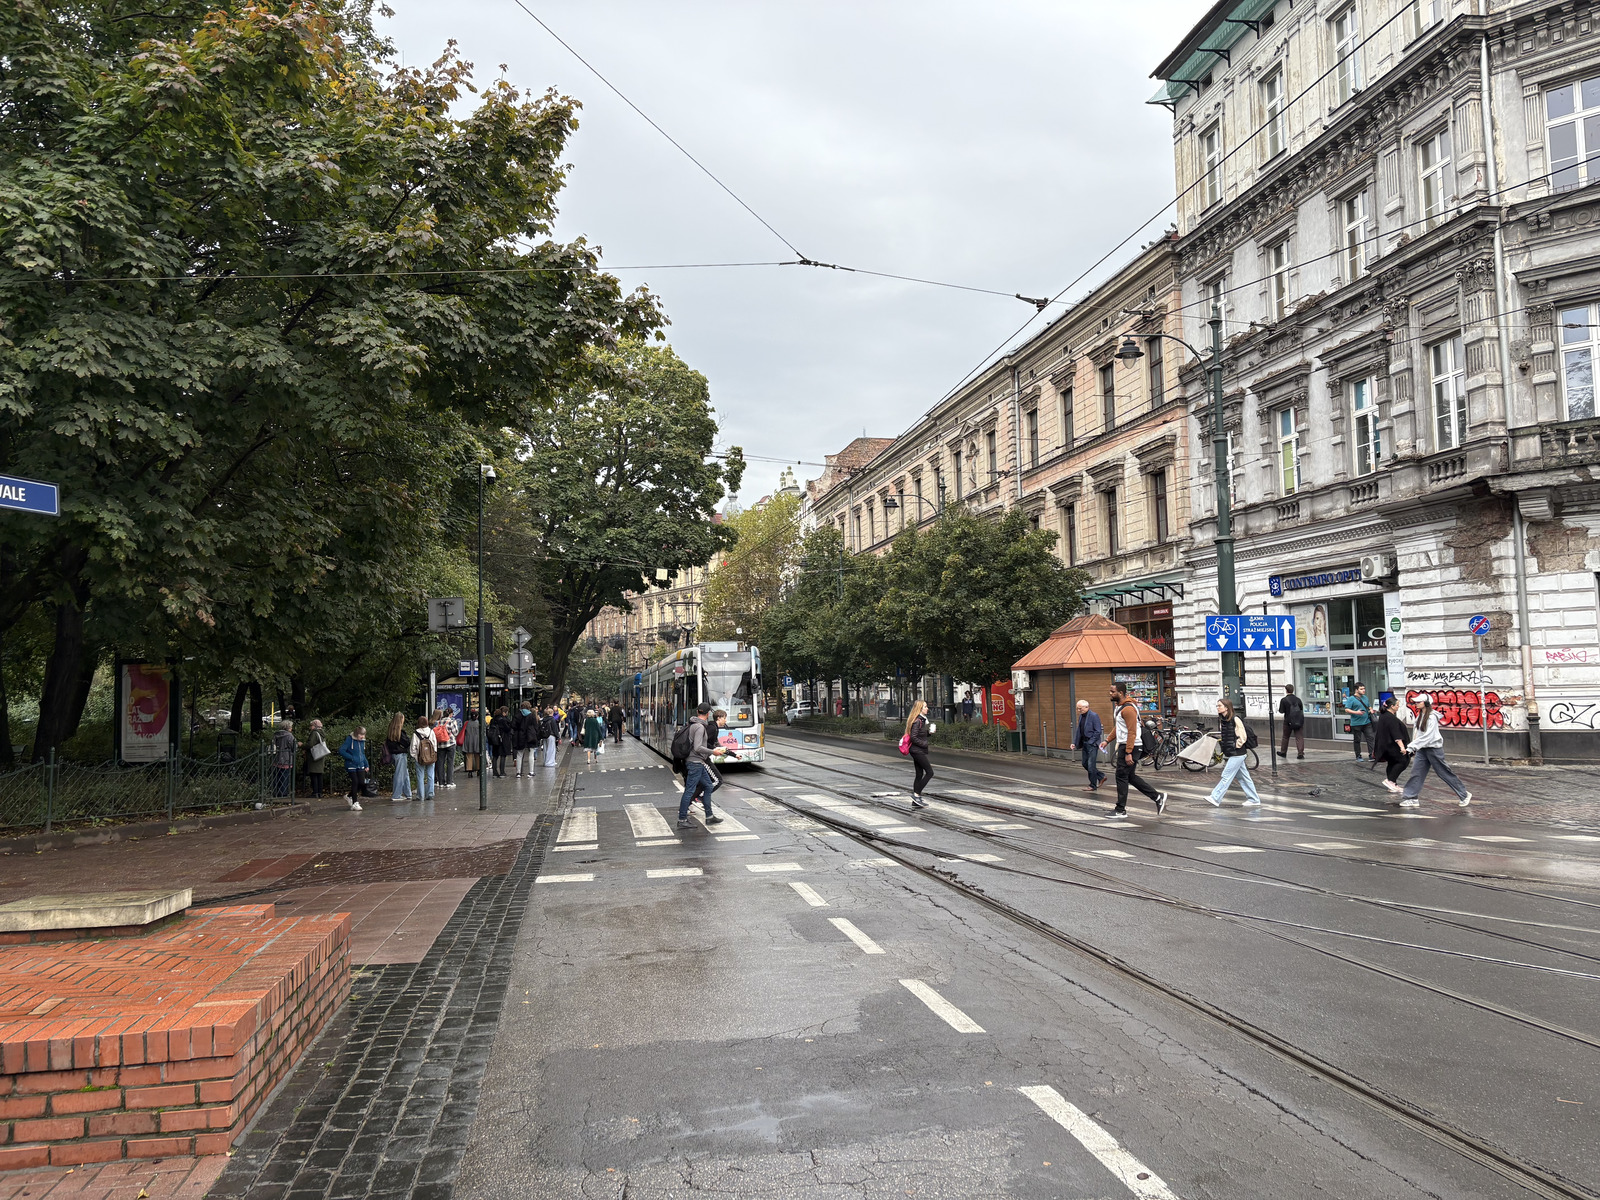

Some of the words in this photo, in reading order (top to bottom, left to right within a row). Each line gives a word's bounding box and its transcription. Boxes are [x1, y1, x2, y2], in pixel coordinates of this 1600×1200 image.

[0, 484, 26, 502] ALE
[1285, 572, 1334, 590] CONTEMPO
[786, 677, 792, 685] P
[127, 705, 141, 714] LAT
[127, 724, 142, 733] DLA
